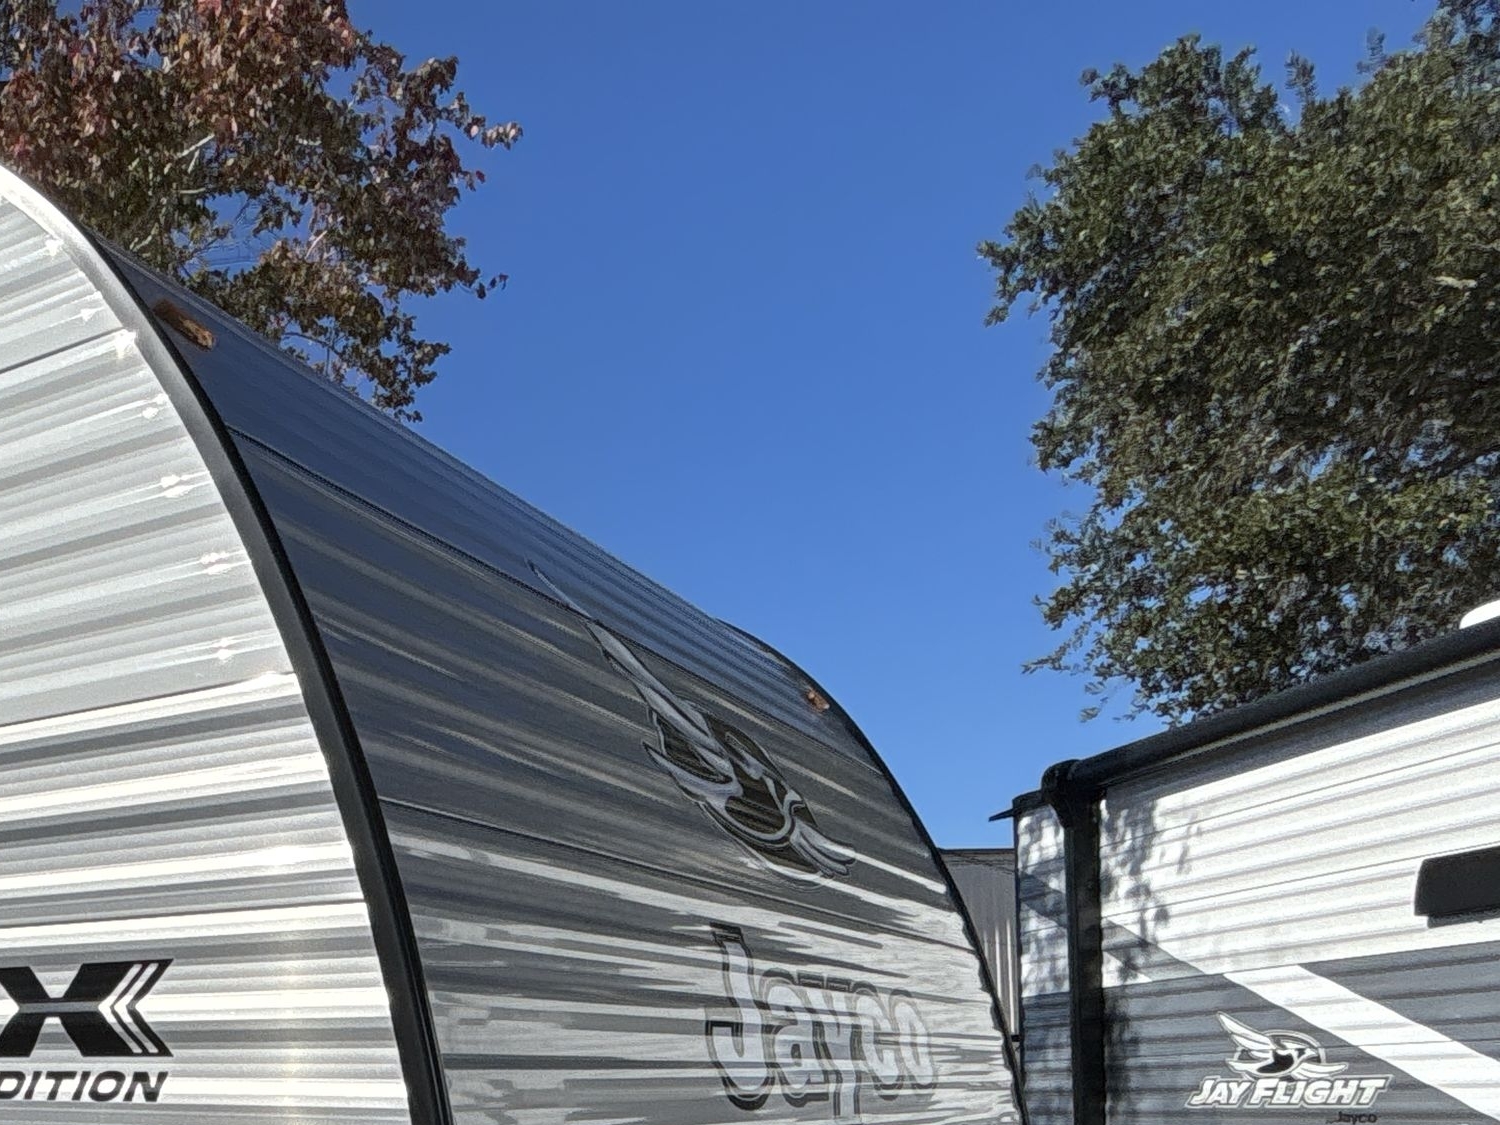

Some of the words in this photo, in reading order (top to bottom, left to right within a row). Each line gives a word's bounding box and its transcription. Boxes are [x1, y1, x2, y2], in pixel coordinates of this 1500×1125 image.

[1188, 1077, 1250, 1106] JAY
[1248, 1076, 1389, 1106] FLIGHT
[1334, 1111, 1377, 1125] Jayco
